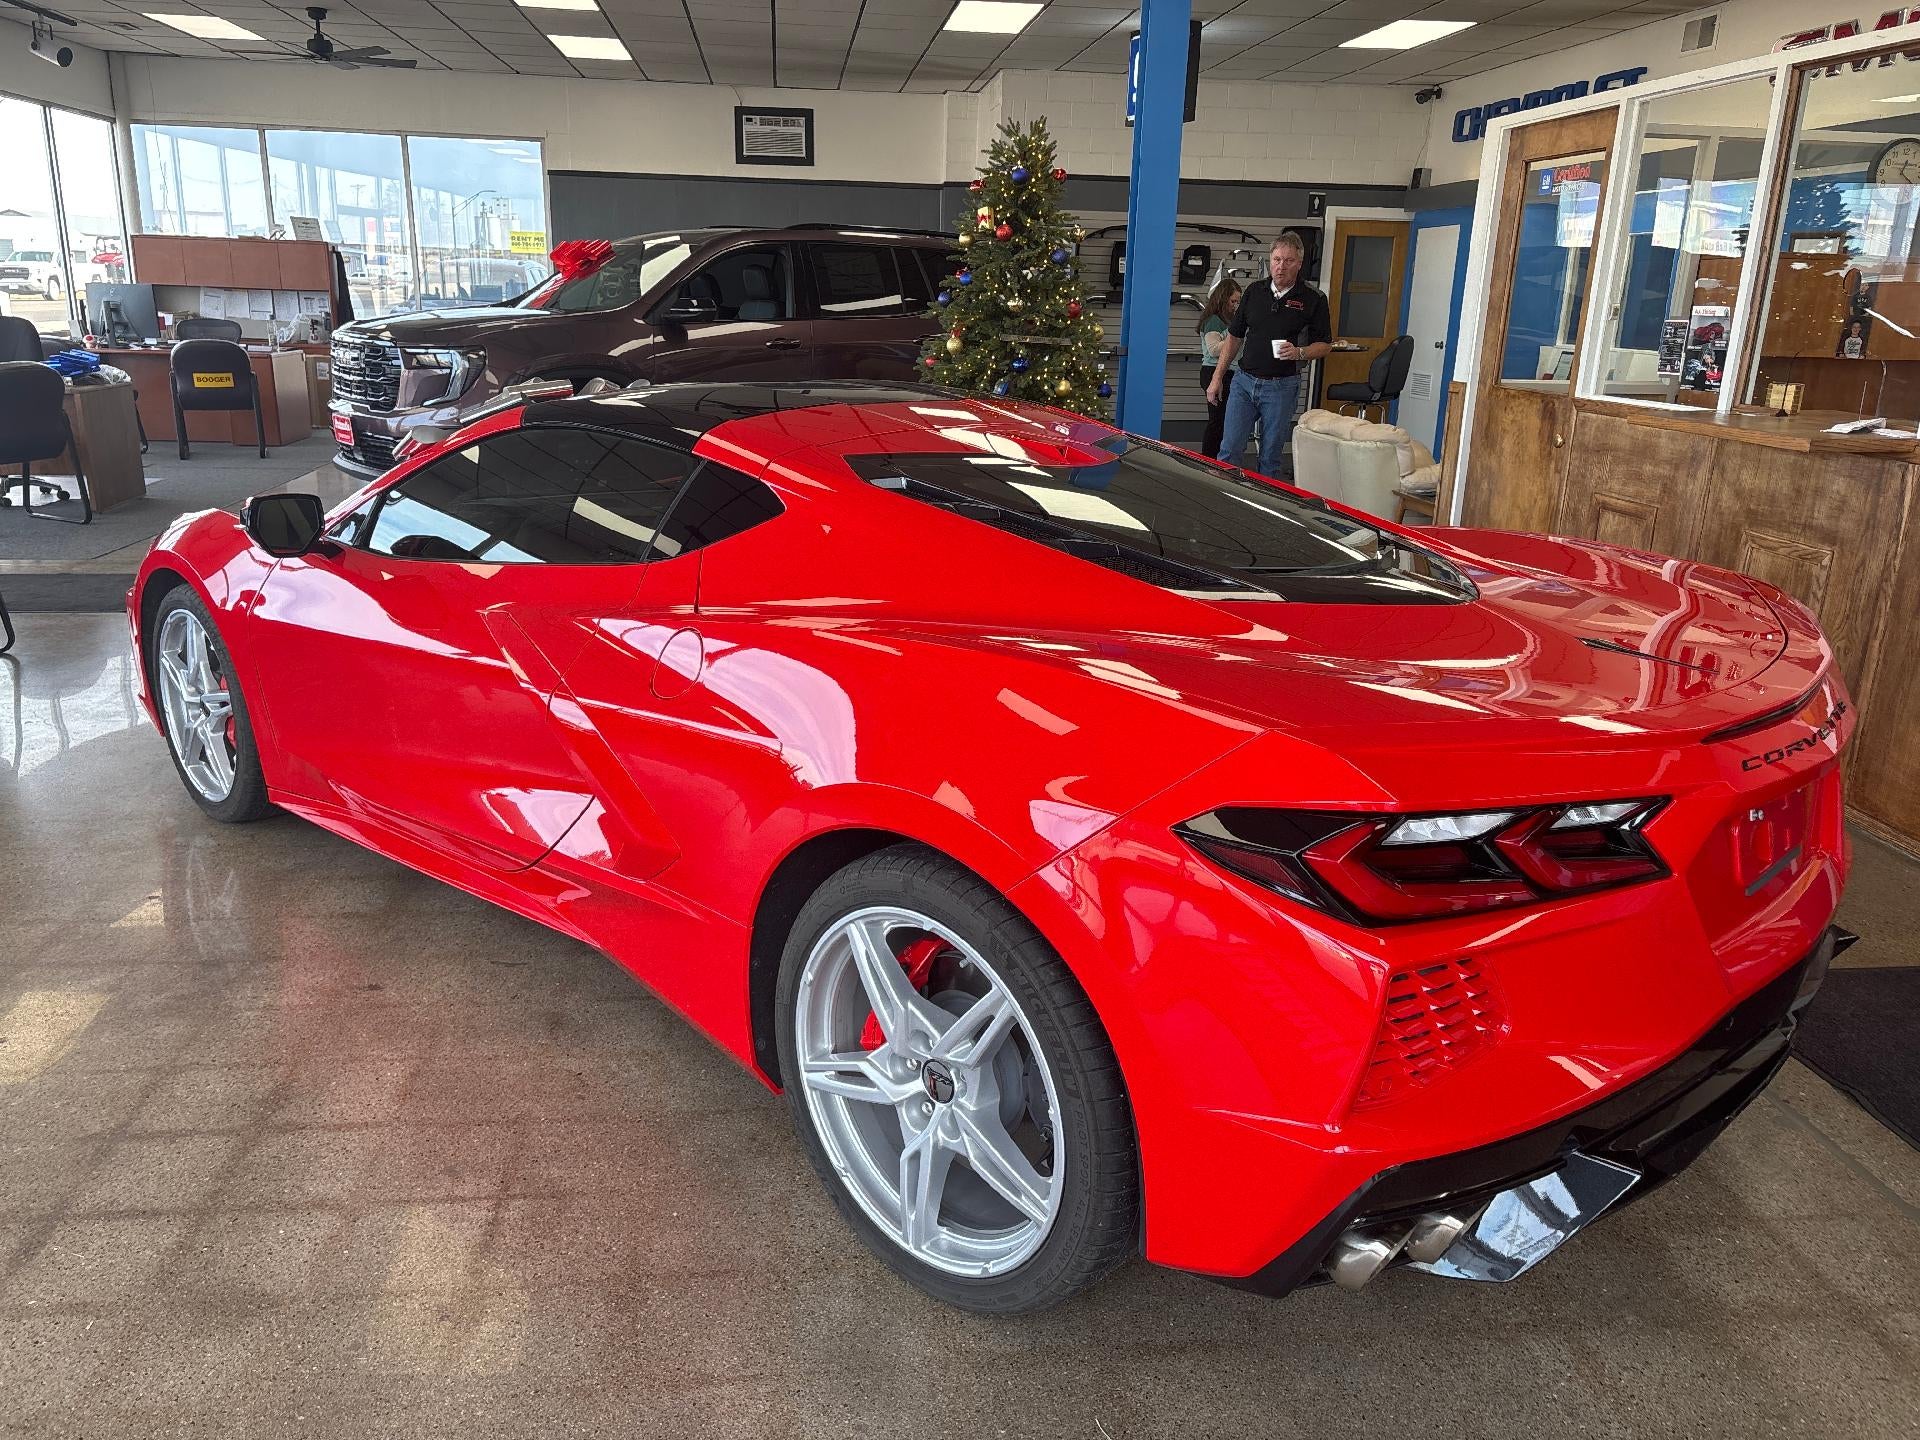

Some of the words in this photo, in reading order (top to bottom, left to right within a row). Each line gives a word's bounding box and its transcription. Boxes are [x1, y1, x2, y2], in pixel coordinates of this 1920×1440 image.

[1884, 158, 1892, 167] 10
[1553, 165, 1591, 182] Certified
[1880, 168, 1885, 177] 9
[1741, 701, 1847, 772] CORVETTE
[1010, 965, 1078, 1094] MICHELIN
